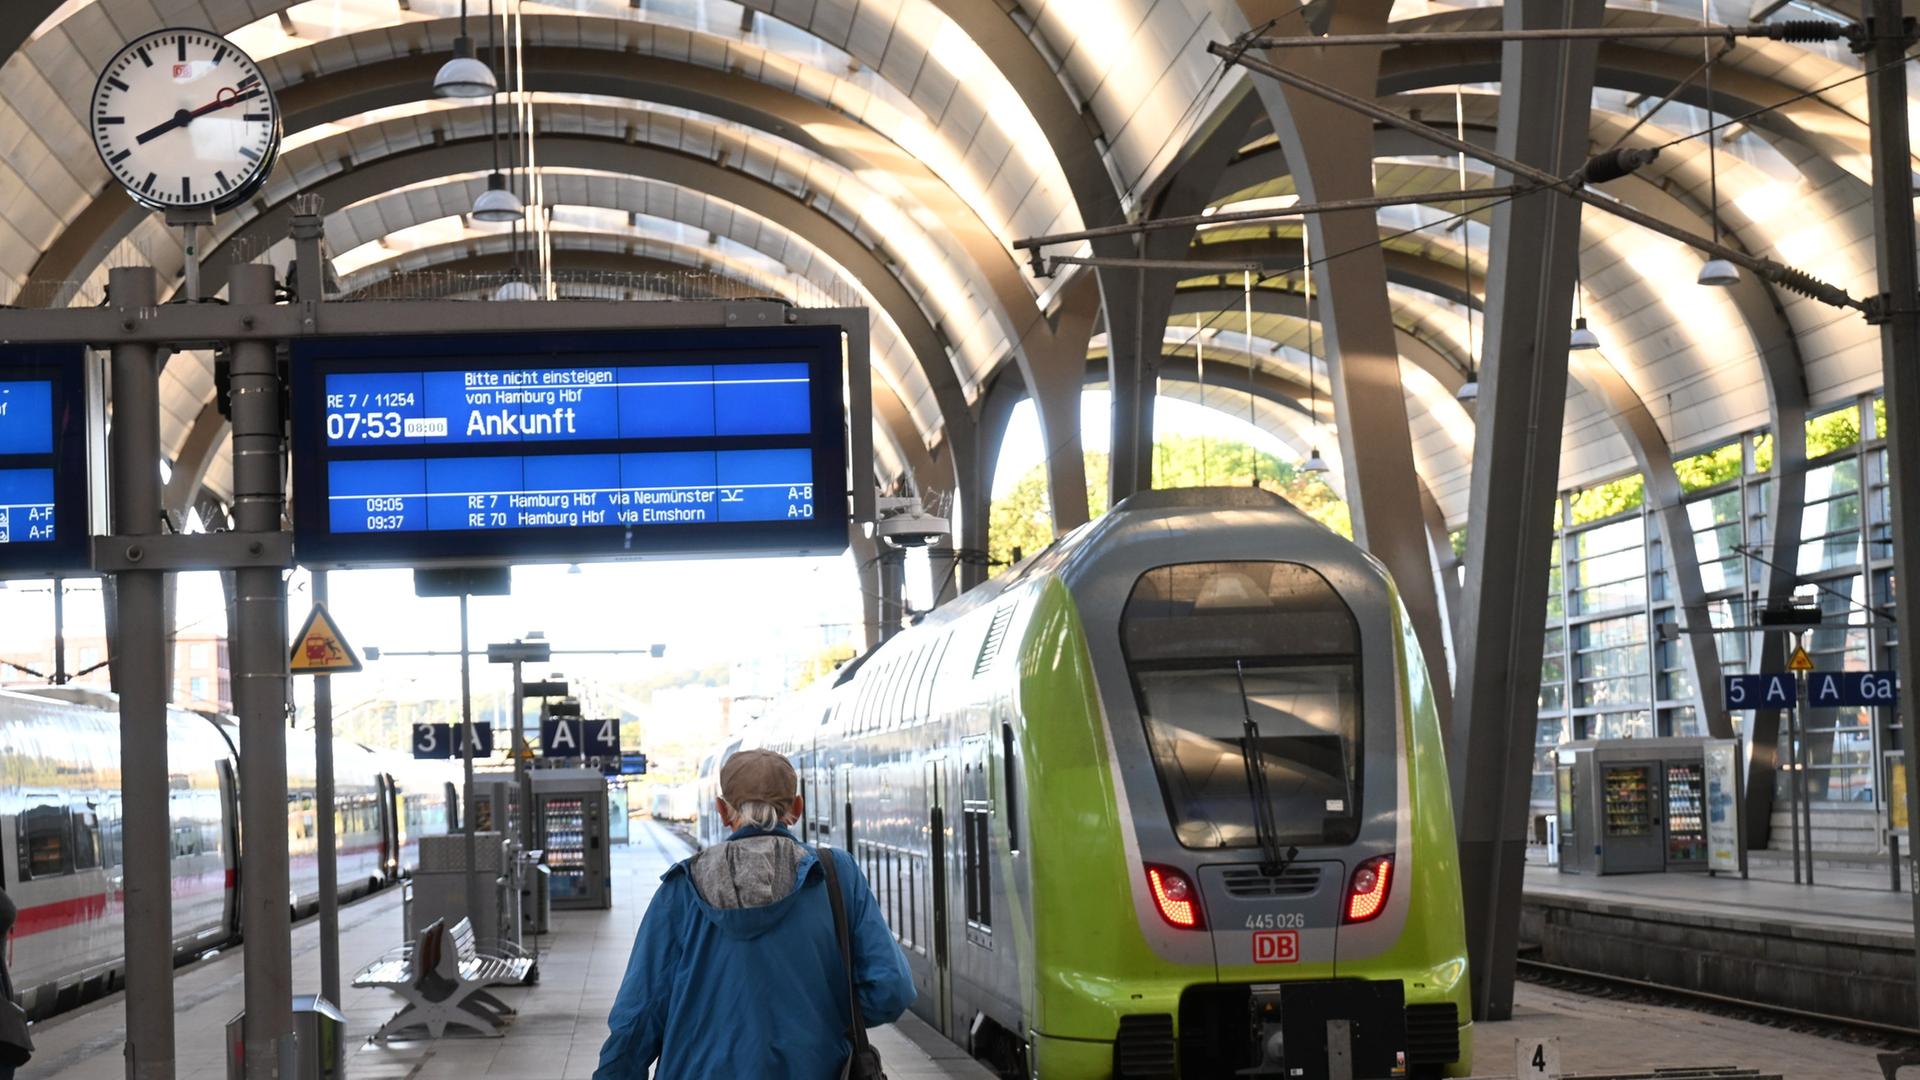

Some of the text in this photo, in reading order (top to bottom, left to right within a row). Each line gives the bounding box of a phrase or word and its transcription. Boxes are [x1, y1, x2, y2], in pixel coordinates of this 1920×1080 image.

[464, 370, 613, 386] Bitte nicht einsteigen
[327, 394, 344, 408] RE
[349, 394, 357, 407] 7
[375, 392, 415, 407] 11254
[465, 388, 583, 405] von Hamburg Hbf
[326, 412, 444, 440] 07:53 08:00
[466, 407, 576, 436] Ankunft
[366, 486, 813, 512] 09:05 RE 7 Hamburg Hbf via Neumünster A-B
[29, 507, 53, 521] A-F
[367, 503, 813, 530] 09:37 RE 70 Hamburg Hbf via Elmshorn A-D
[29, 525, 54, 539] A-F
[1730, 676, 1786, 703] 5 A
[1820, 674, 1892, 699] A 6a
[418, 724, 436, 751] 3
[551, 719, 615, 748] A 4
[1245, 913, 1305, 929] 445 026
[1258, 935, 1294, 958] DB
[1532, 1044, 1545, 1072] 4
